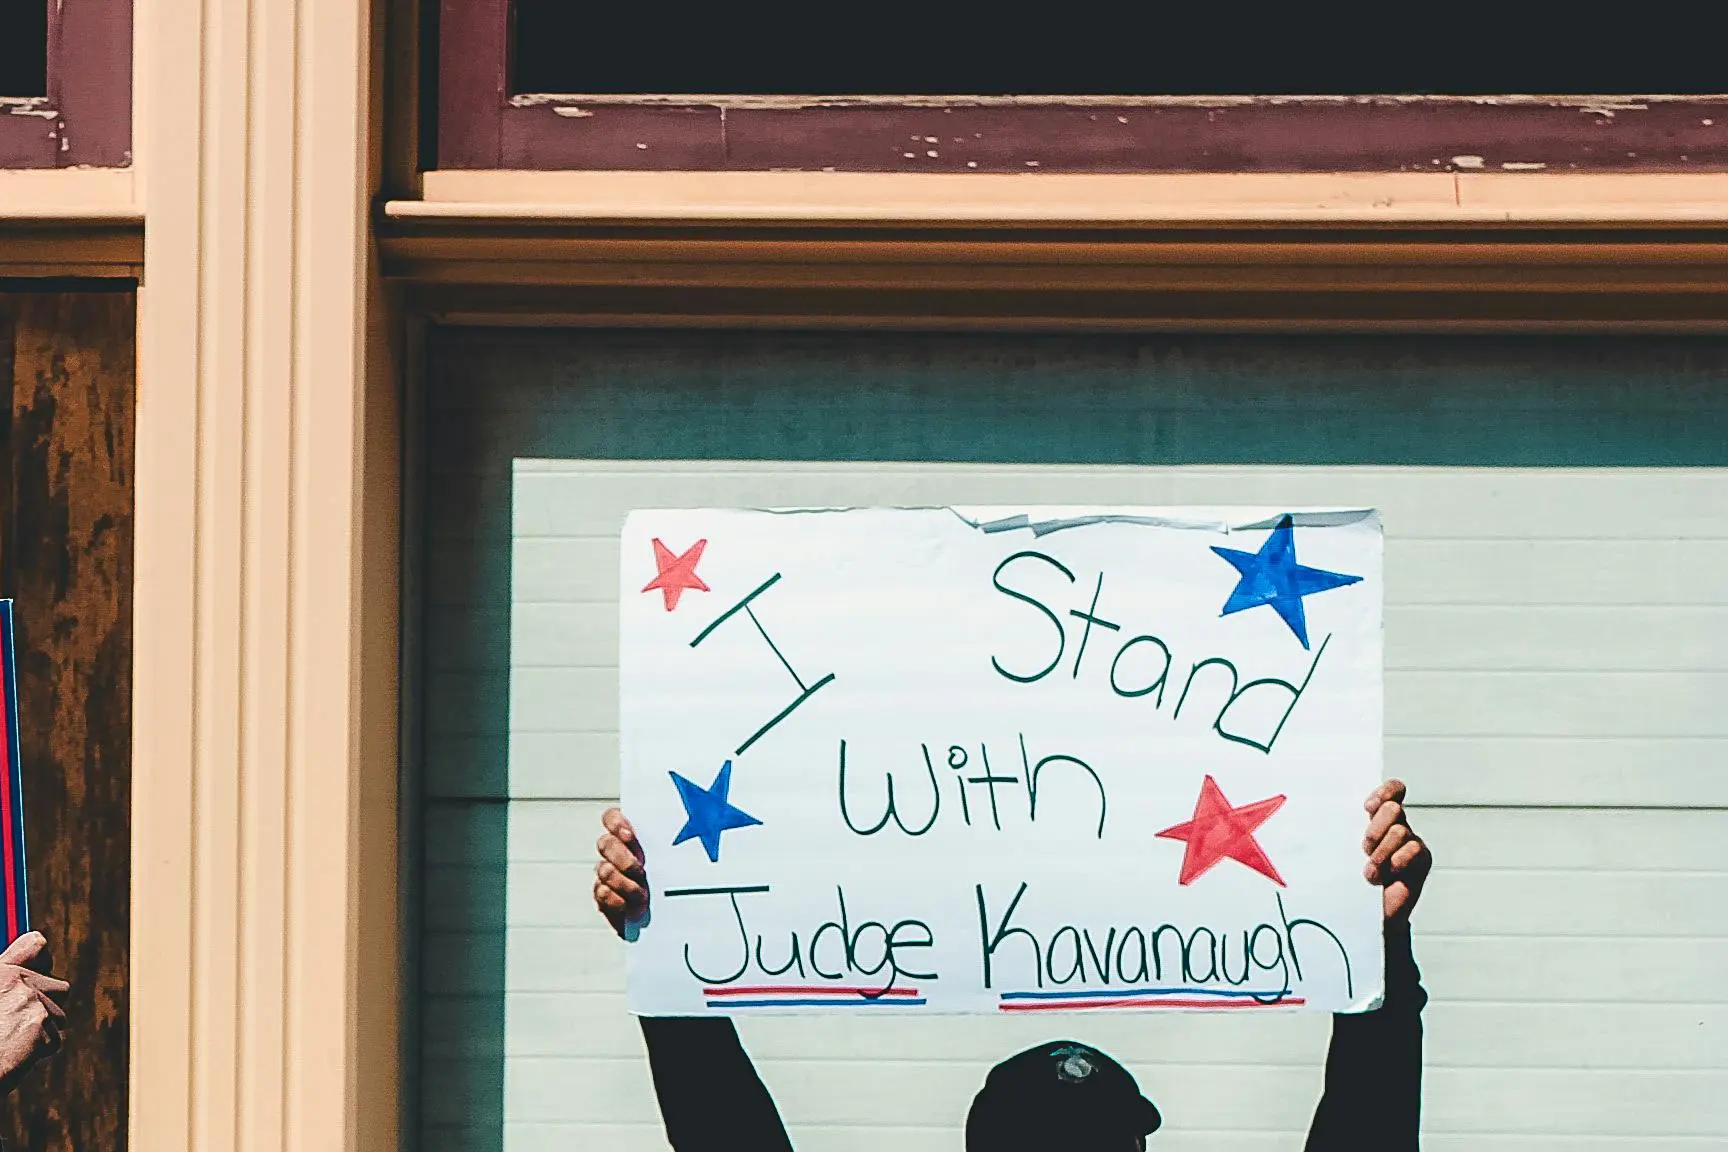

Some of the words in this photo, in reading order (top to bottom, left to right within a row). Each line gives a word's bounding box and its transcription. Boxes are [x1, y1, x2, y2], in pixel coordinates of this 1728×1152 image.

[689, 572, 836, 755] I
[990, 551, 1332, 754] Stand
[839, 732, 1106, 840] With
[664, 884, 938, 1001] Judge
[976, 882, 1354, 1005] Kavanaugh
